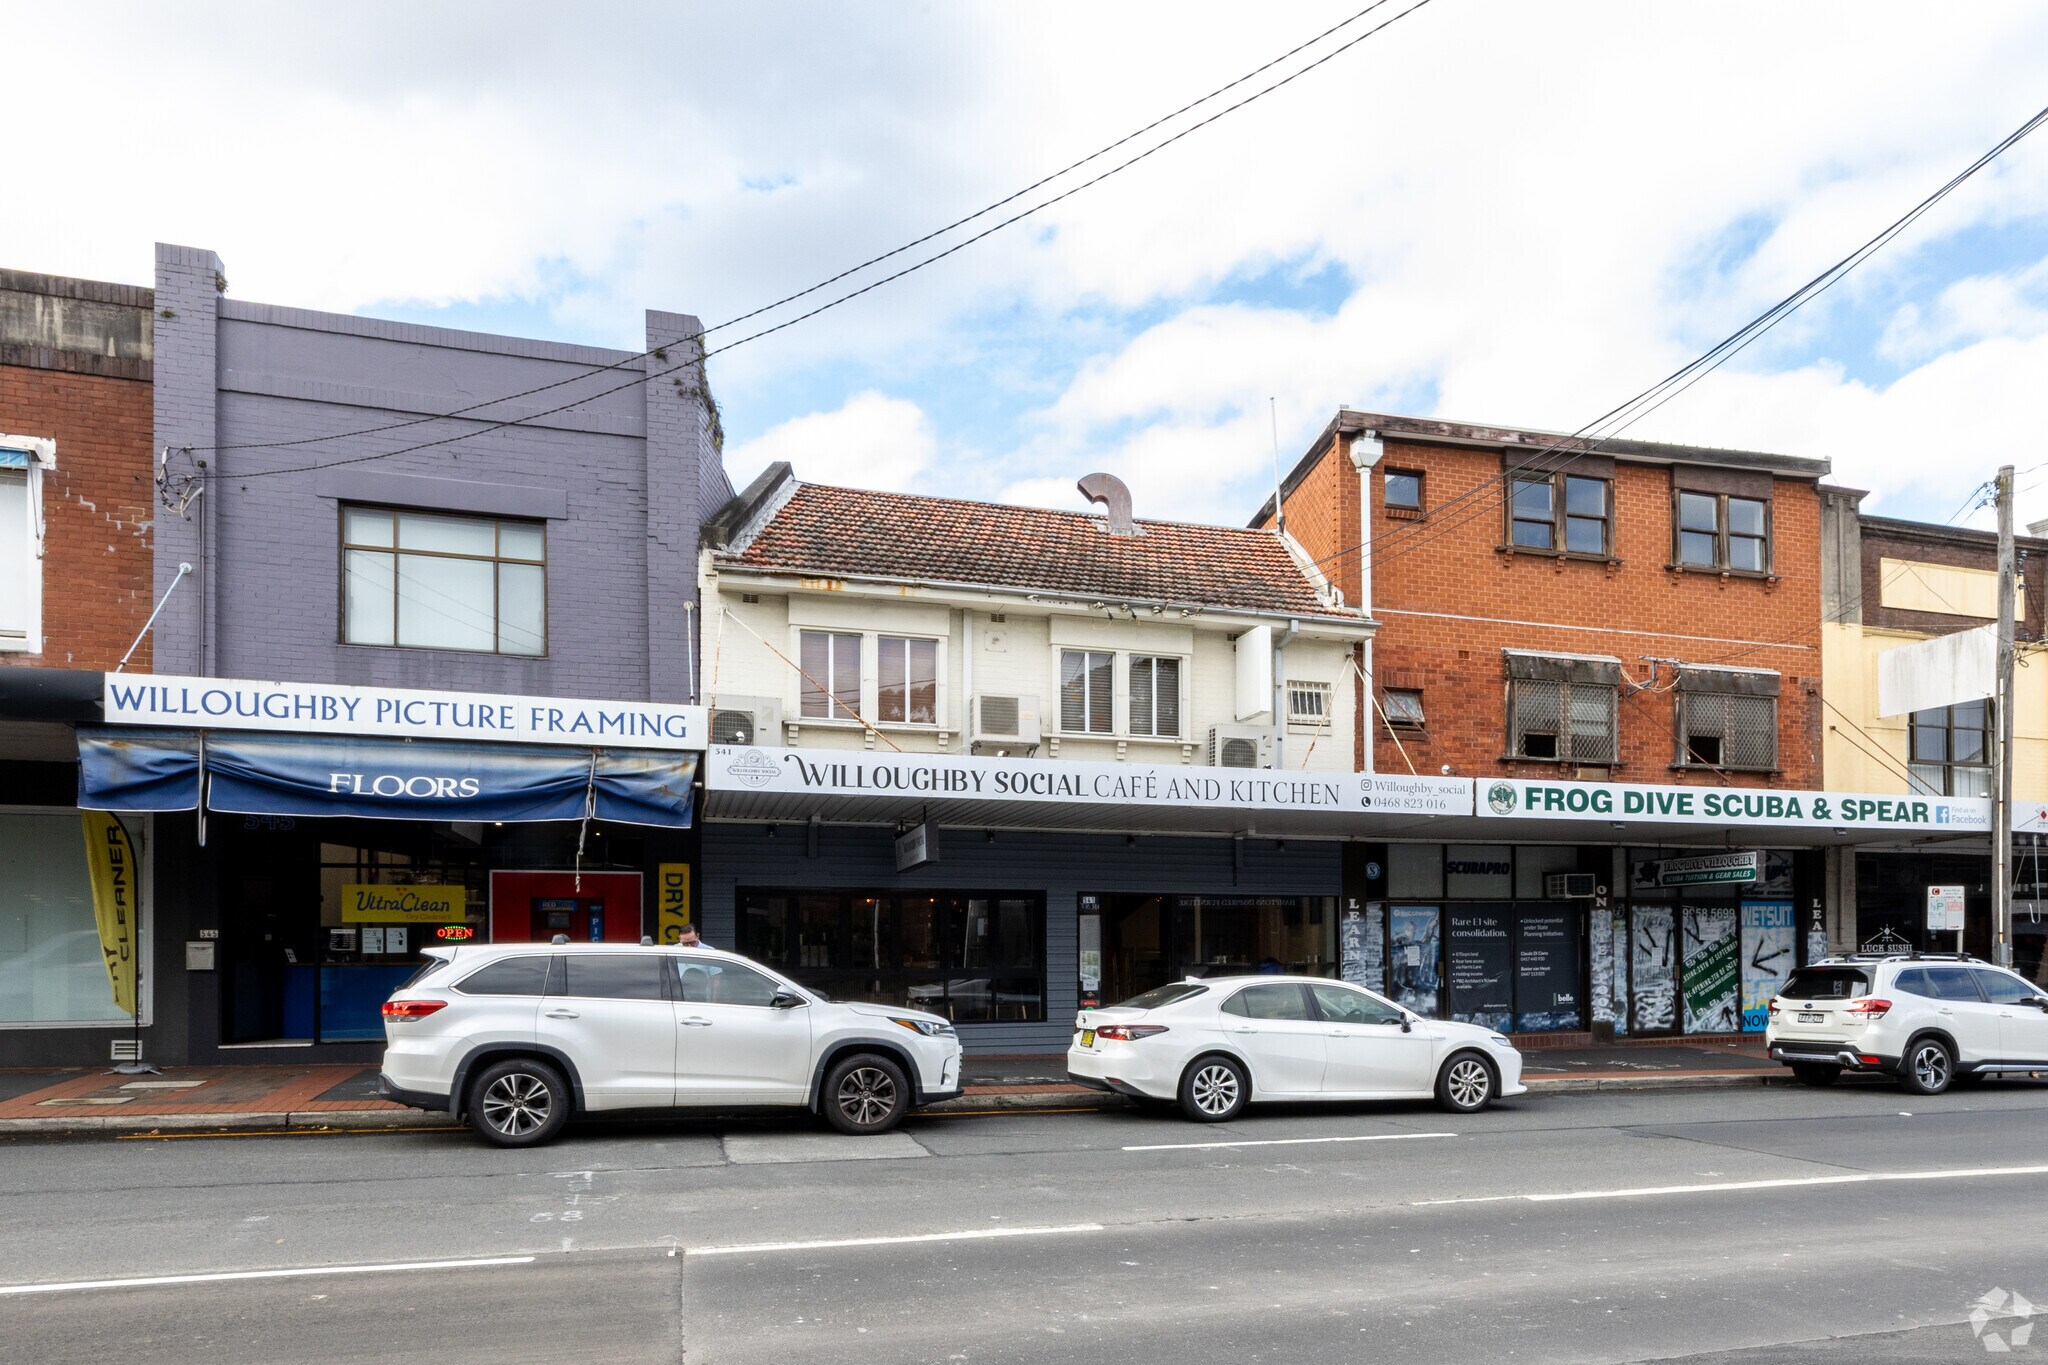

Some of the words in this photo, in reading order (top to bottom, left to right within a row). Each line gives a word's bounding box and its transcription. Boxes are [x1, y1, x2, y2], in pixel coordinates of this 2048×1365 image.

[110, 684, 362, 722] WILLOUGHBY
[376, 698, 516, 730] PICTURE
[530, 706, 687, 738] FRAMING
[715, 748, 732, 756] 541
[327, 773, 480, 799] FLOORS
[784, 754, 987, 793] WILLOUGHBY
[994, 770, 1090, 797] SOCIAL
[1093, 770, 1159, 799] CAFÉ
[1166, 777, 1221, 801] AND
[1230, 779, 1340, 806] KITCHEN
[1375, 780, 1467, 797] Willoughby_social
[1373, 797, 1401, 808] 0468
[1403, 797, 1424, 809] 823
[1426, 798, 1447, 810] 016
[1525, 786, 1613, 813] FROG
[1624, 790, 1695, 815] DIVE
[1703, 793, 1804, 819] SCUBA
[1811, 797, 1833, 820] &
[1841, 799, 1930, 823] SPEAR
[1951, 814, 1988, 825] Facebook
[1446, 861, 1510, 875] SCUBAPRO
[1664, 859, 1685, 873] FROG
[1684, 858, 1704, 871] DIVE
[1704, 854, 1755, 869] WILLOUGHBY
[1665, 874, 1684, 884] SCUBA
[1714, 871, 1732, 880] GEAR
[1732, 870, 1751, 879] SALES
[106, 824, 130, 962] CLEANER
[664, 872, 685, 918] DRY
[355, 890, 450, 912] UltraClean
[1710, 908, 1736, 919] 5699
[1741, 905, 1793, 927] WETSUIT
[1451, 917, 1472, 926] Rare
[1483, 917, 1498, 926] site
[201, 930, 218, 938] 545
[436, 927, 475, 939] OPEN
[1451, 929, 1508, 938] consolidation.
[1861, 944, 1885, 952] LUCK
[1887, 944, 1913, 952] SUSHI
[1557, 993, 1574, 1002] belle
